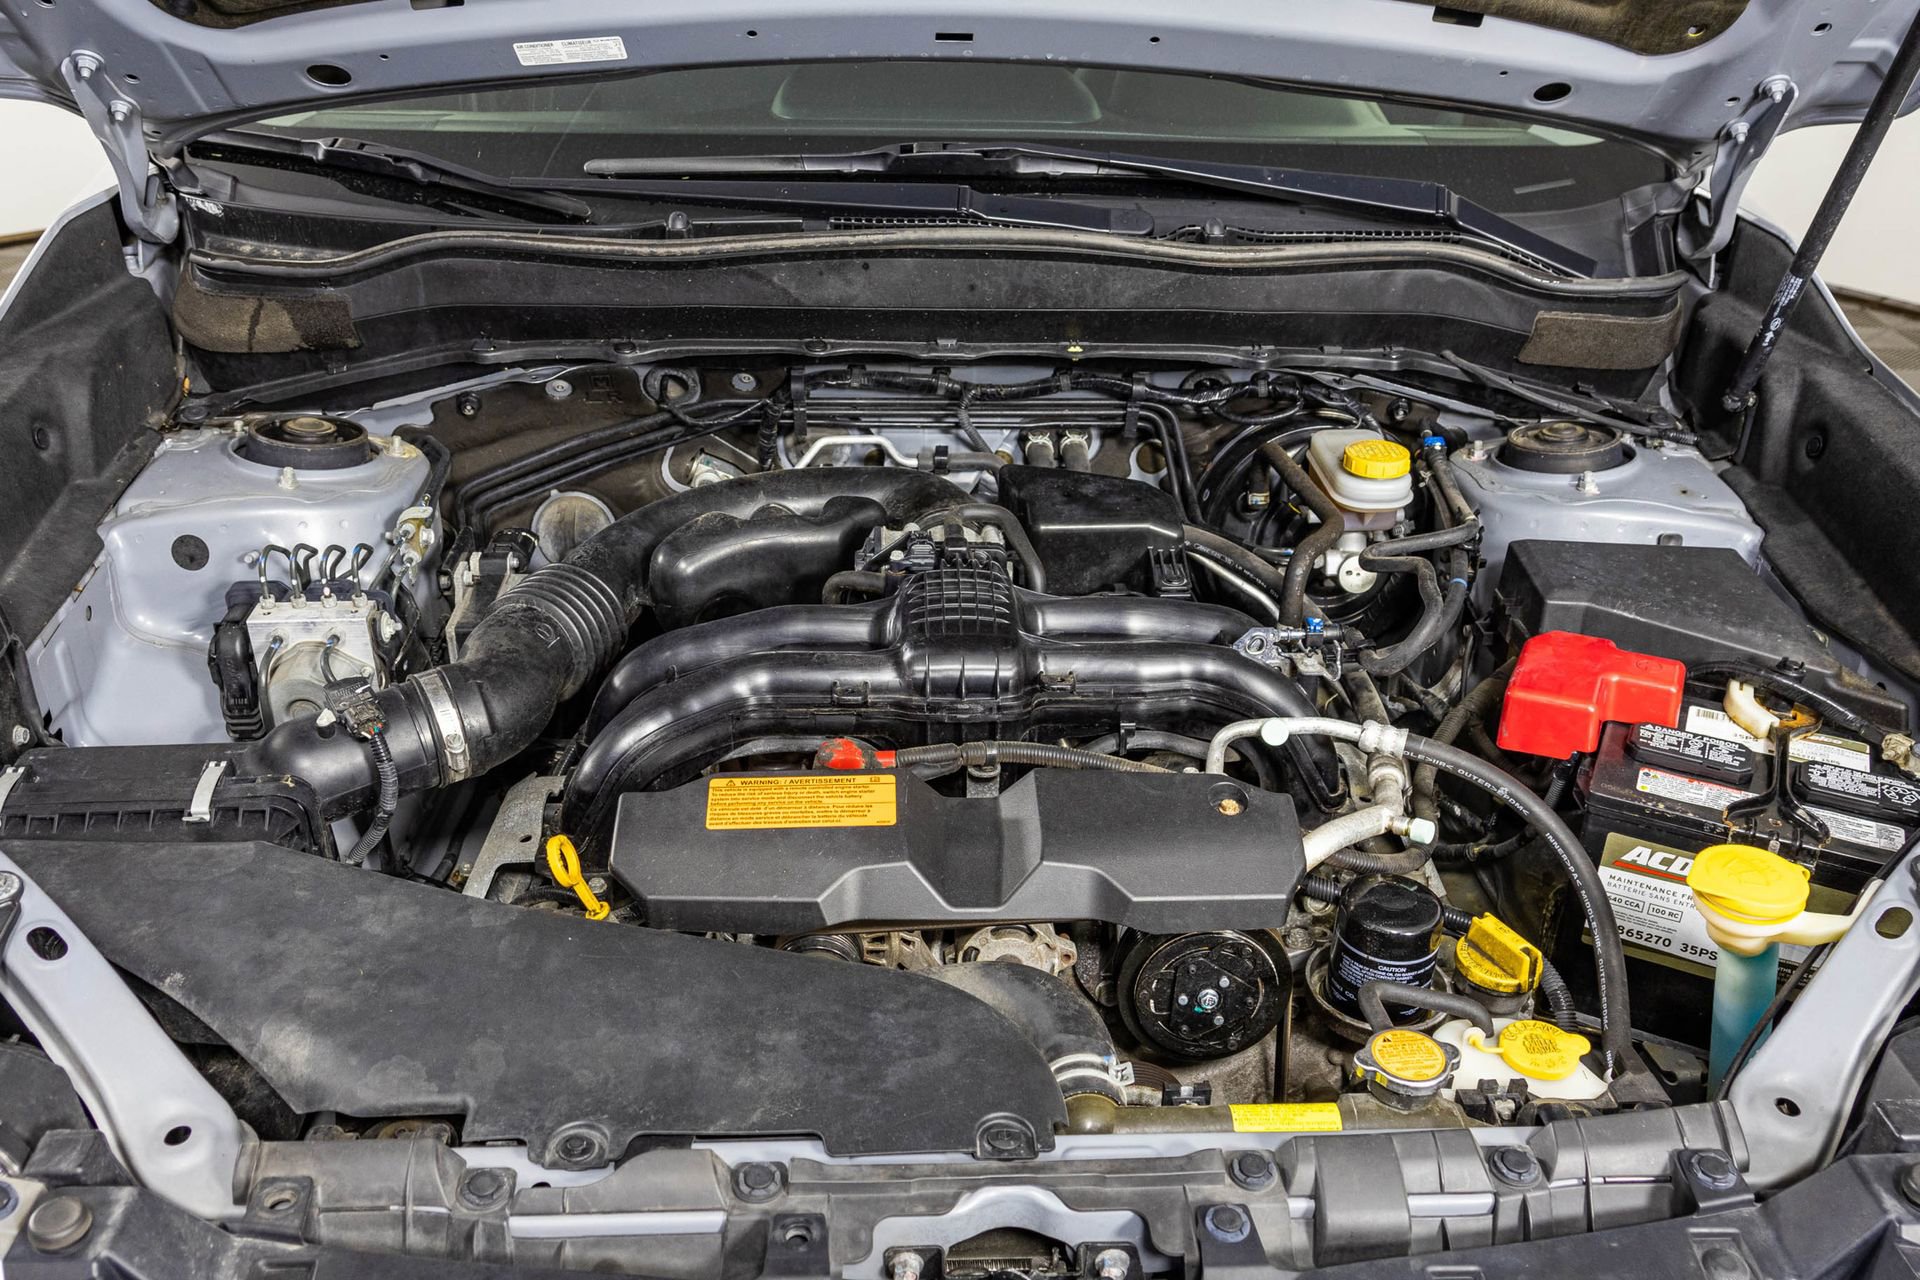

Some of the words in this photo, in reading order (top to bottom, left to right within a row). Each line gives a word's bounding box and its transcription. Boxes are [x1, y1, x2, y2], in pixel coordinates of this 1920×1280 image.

[1654, 726, 1694, 740] DANGER
[1703, 737, 1739, 749] POISON
[1606, 881, 1647, 896] BATTERIE
[1648, 893, 1670, 902] SANS
[1608, 874, 1678, 897] MAINTENANCE
[1624, 900, 1640, 909] CCA
[1652, 907, 1666, 916] 100
[1668, 911, 1679, 919] RC
[1618, 925, 1672, 947] 865270
[1680, 943, 1718, 960] 35PS
[1378, 965, 1407, 973] CAUTION
